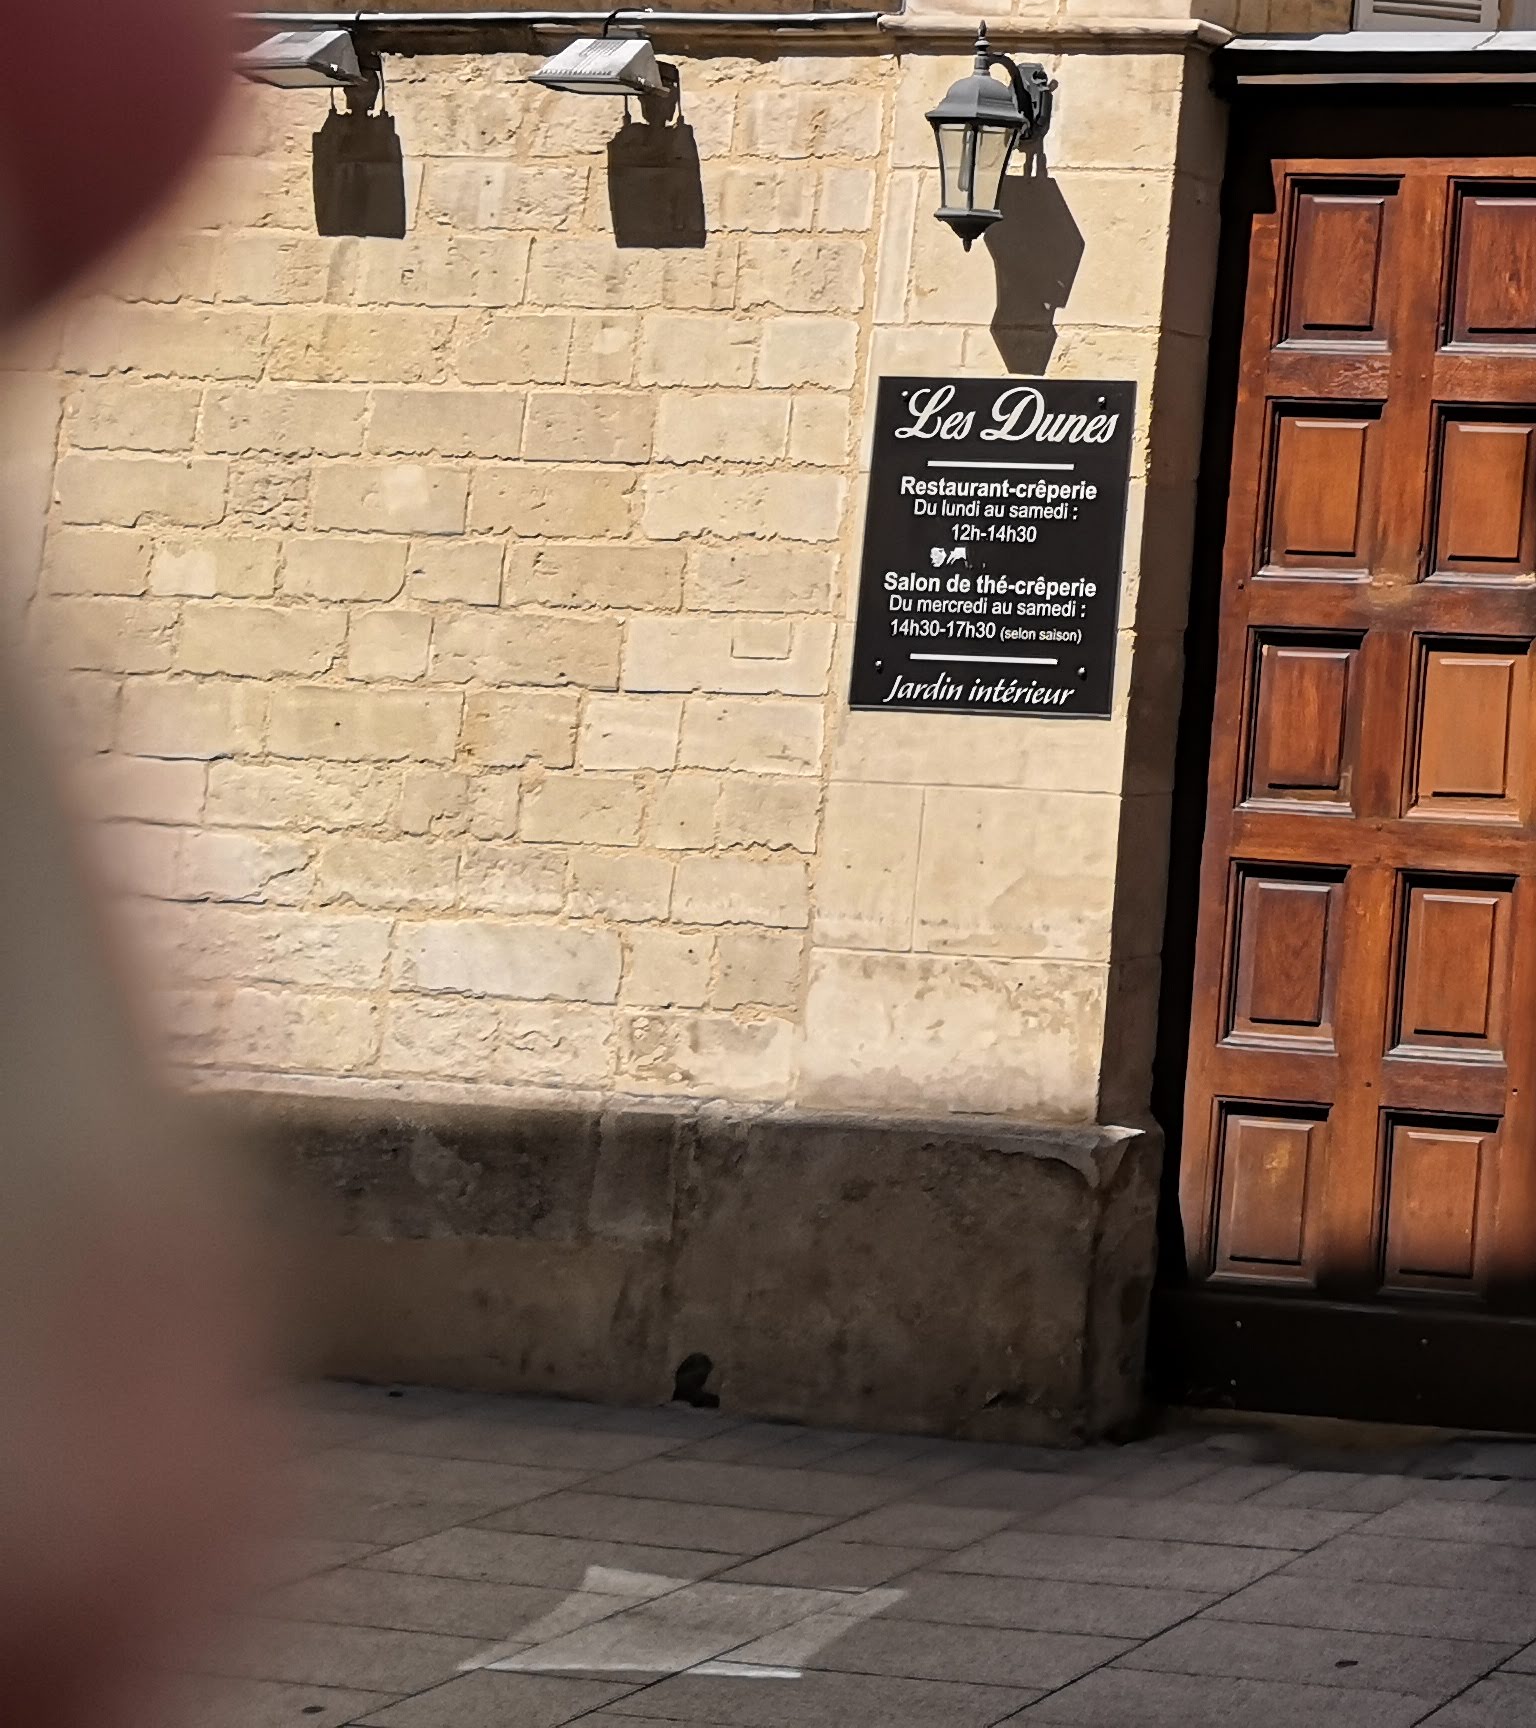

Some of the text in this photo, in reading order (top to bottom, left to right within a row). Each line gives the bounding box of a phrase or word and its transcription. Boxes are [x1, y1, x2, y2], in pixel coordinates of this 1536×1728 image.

[895, 384, 1120, 443] Les Dunes
[900, 475, 1098, 503] Restaurant-crêperie
[913, 498, 938, 516] Du
[941, 499, 981, 517] lundi
[984, 503, 1005, 518] au
[1008, 502, 1069, 520] samedi
[951, 523, 1037, 543] 12h-14h30
[883, 571, 1098, 600] Salon de thé-crêperie
[889, 594, 912, 612] Du
[916, 595, 988, 615] mercredi
[991, 600, 1012, 616] au
[1016, 600, 1076, 618] samedi
[890, 618, 1082, 645] 14h30-17h30 (selon saison)
[882, 671, 1075, 705] Jardin intérieur
